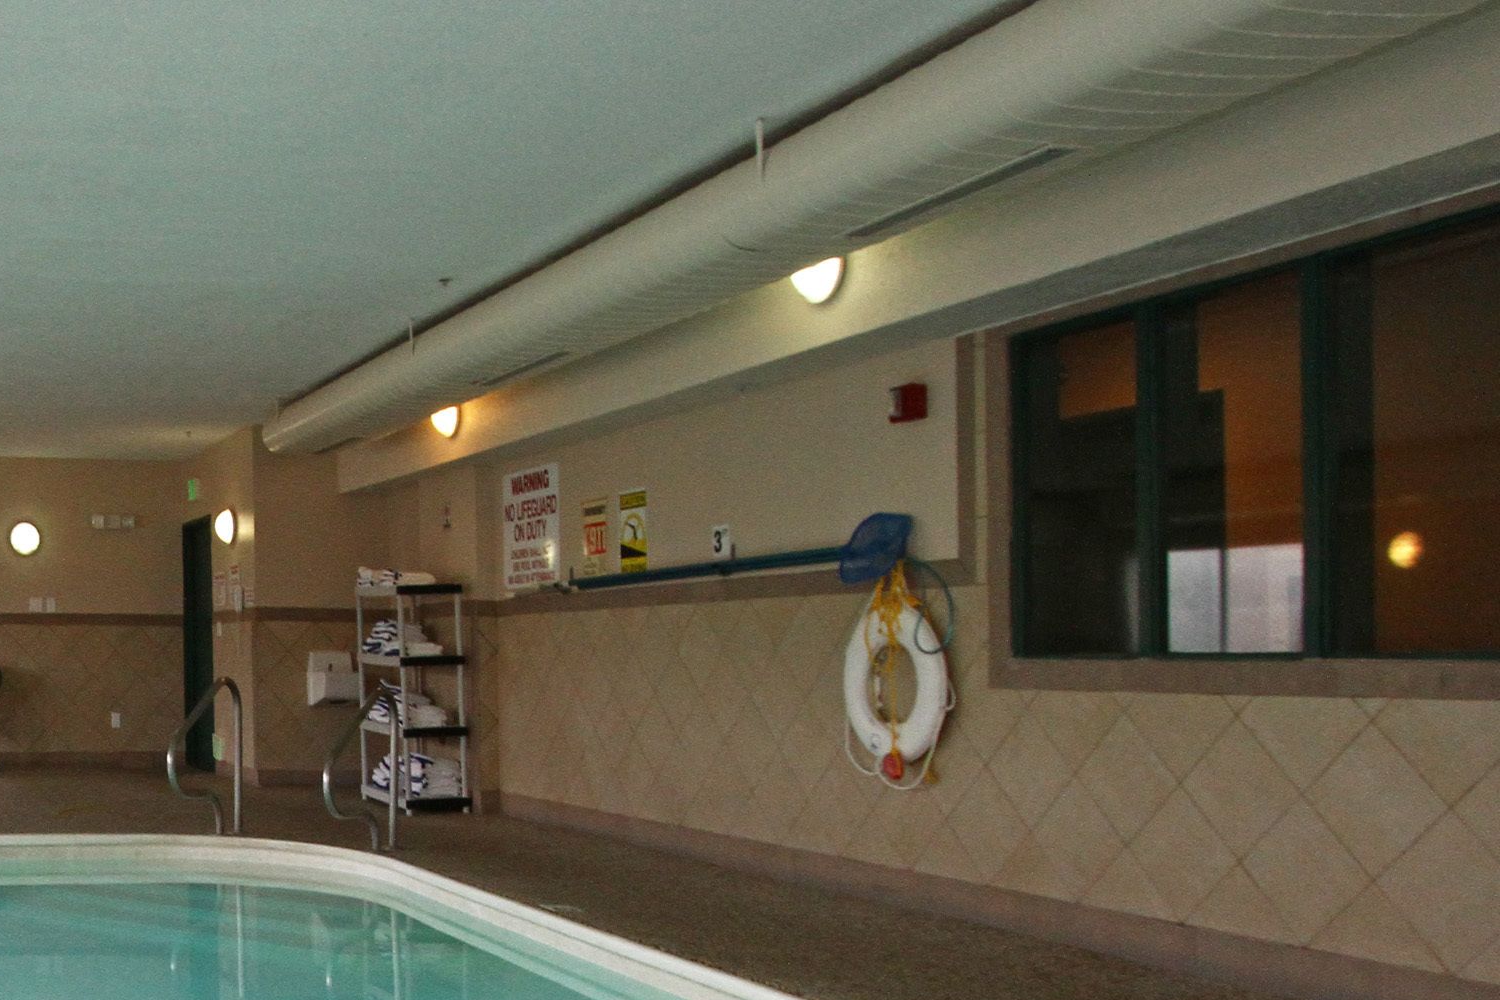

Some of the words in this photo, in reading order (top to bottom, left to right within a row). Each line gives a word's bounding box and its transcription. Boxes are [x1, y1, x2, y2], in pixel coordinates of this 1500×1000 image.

[511, 469, 549, 496] WARNING
[504, 503, 515, 521] NO
[516, 495, 556, 520] LIFEGUARD
[514, 523, 525, 541] ON
[526, 519, 546, 540] DUTY
[713, 530, 722, 553] 3
